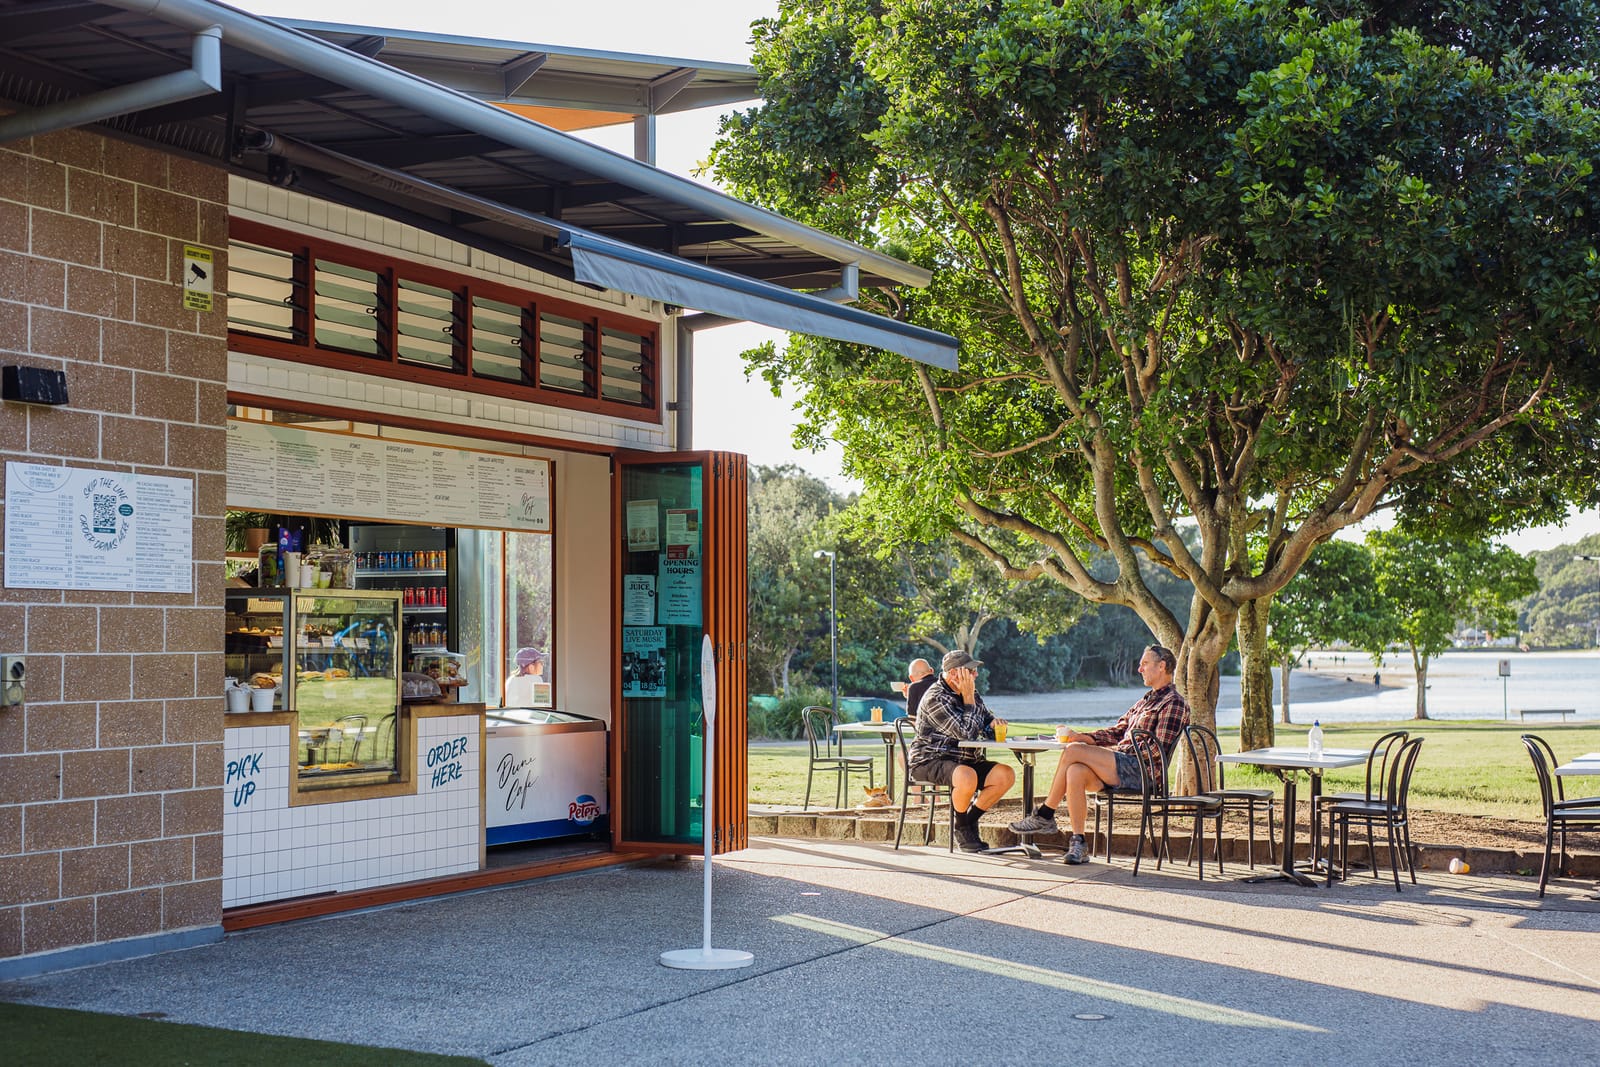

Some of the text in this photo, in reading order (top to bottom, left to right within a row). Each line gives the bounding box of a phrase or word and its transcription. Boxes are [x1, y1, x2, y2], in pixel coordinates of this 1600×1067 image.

[83, 477, 128, 500] SKIP THE LINE
[80, 514, 95, 544] ORDER
[119, 519, 130, 544] HERE
[663, 559, 699, 567] OPENING
[629, 583, 650, 591] JUICE
[625, 629, 662, 637] SATURDAY
[426, 736, 468, 768] ORDER
[226, 752, 264, 784] PICK
[431, 761, 463, 789] HERE
[233, 781, 256, 807] UP
[568, 801, 600, 820] Peters
